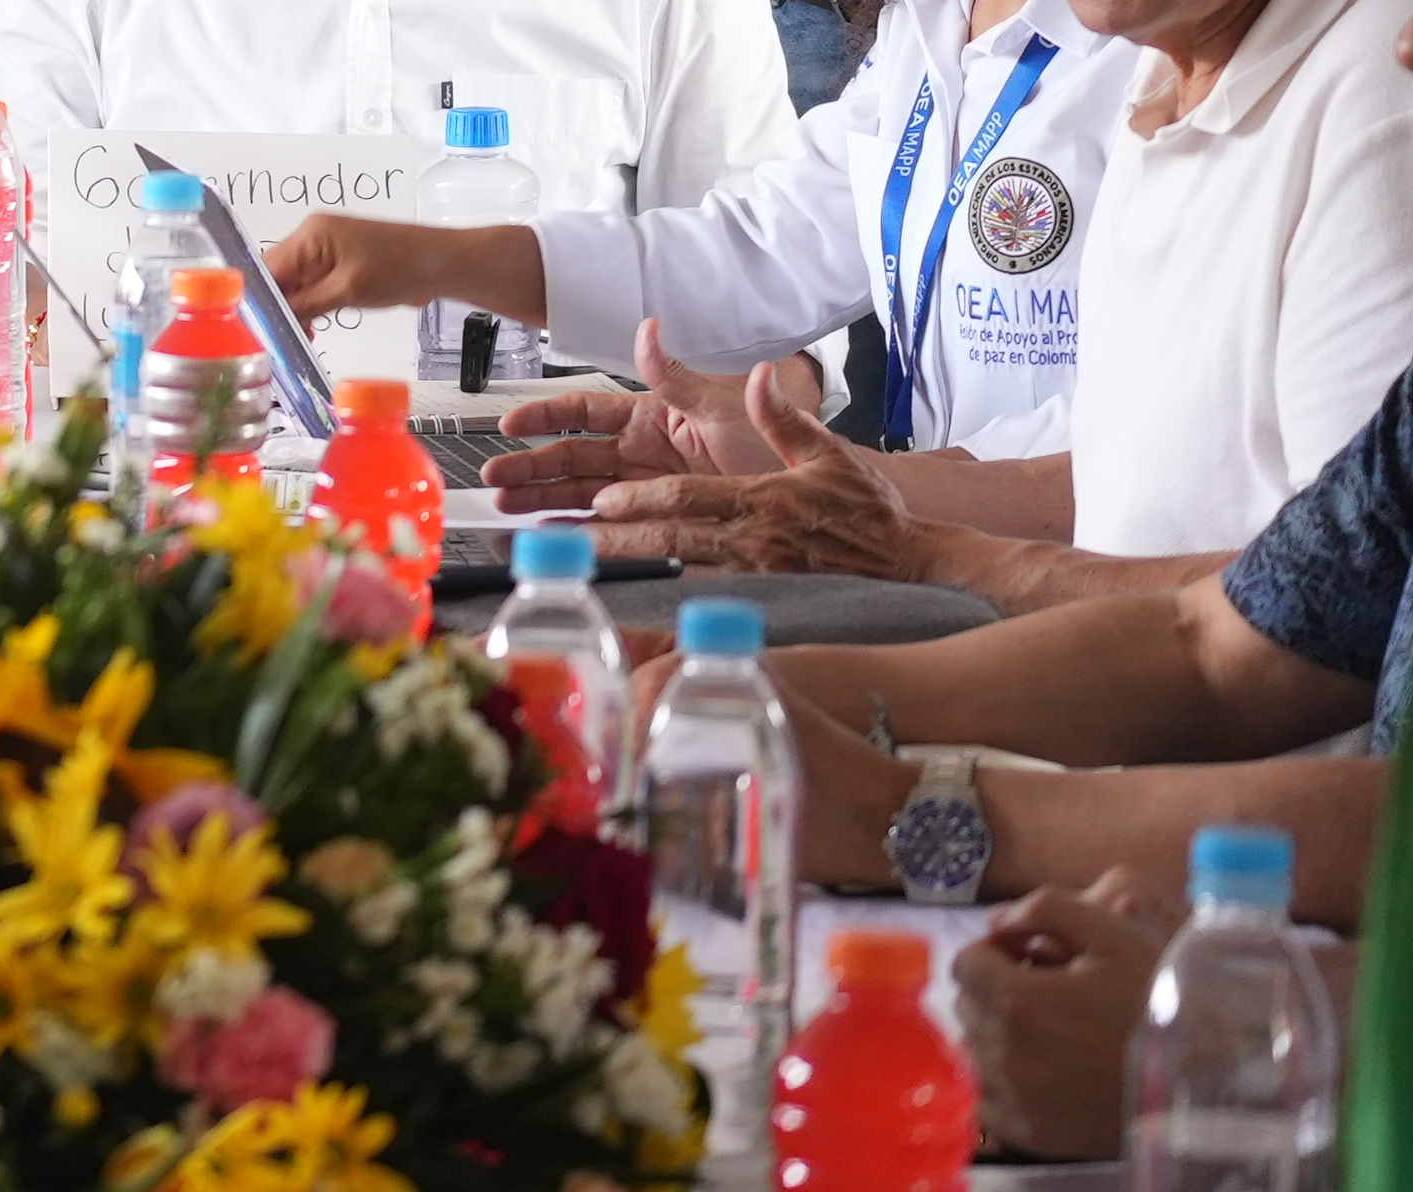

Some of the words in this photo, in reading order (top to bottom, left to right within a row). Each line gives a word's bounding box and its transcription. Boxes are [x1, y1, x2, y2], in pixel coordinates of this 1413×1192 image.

[997, 162, 1016, 174] LOS
[1019, 163, 1062, 198] ESTADOS
[1028, 201, 1070, 266] AMERICANOS
[955, 282, 1010, 323] OEA
[1030, 288, 1079, 325] MA
[980, 326, 994, 343] de
[996, 328, 1038, 349] Apoyo
[1041, 329, 1054, 346] al
[1057, 330, 1078, 346] Pro
[984, 349, 1006, 366] paz
[1009, 351, 1025, 366] en
[1028, 348, 1078, 366] Colomb
